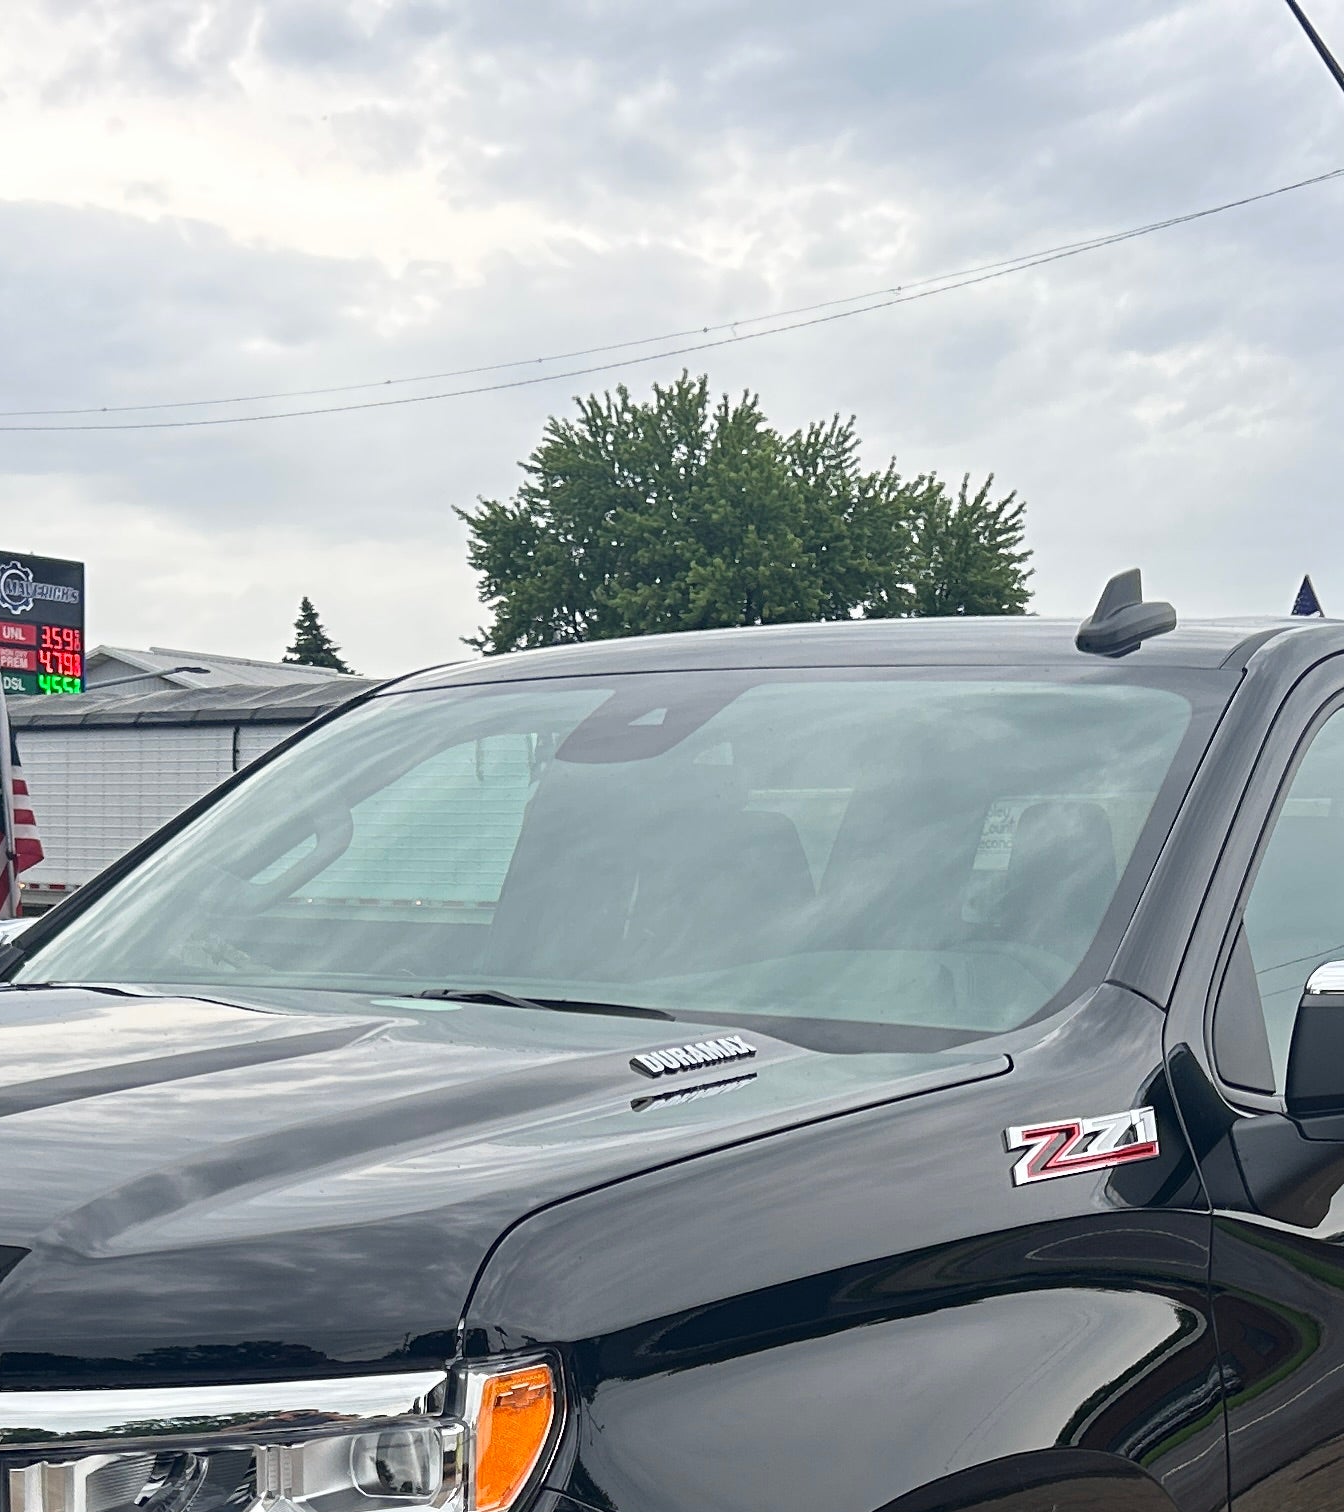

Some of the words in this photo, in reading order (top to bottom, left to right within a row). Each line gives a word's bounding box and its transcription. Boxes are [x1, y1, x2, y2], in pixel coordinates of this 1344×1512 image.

[2, 626, 26, 640] UNL
[0, 656, 28, 669] PREM
[3, 676, 26, 691] DSL
[633, 1035, 757, 1074] DURAMAX
[1008, 1106, 1158, 1186] Z71
